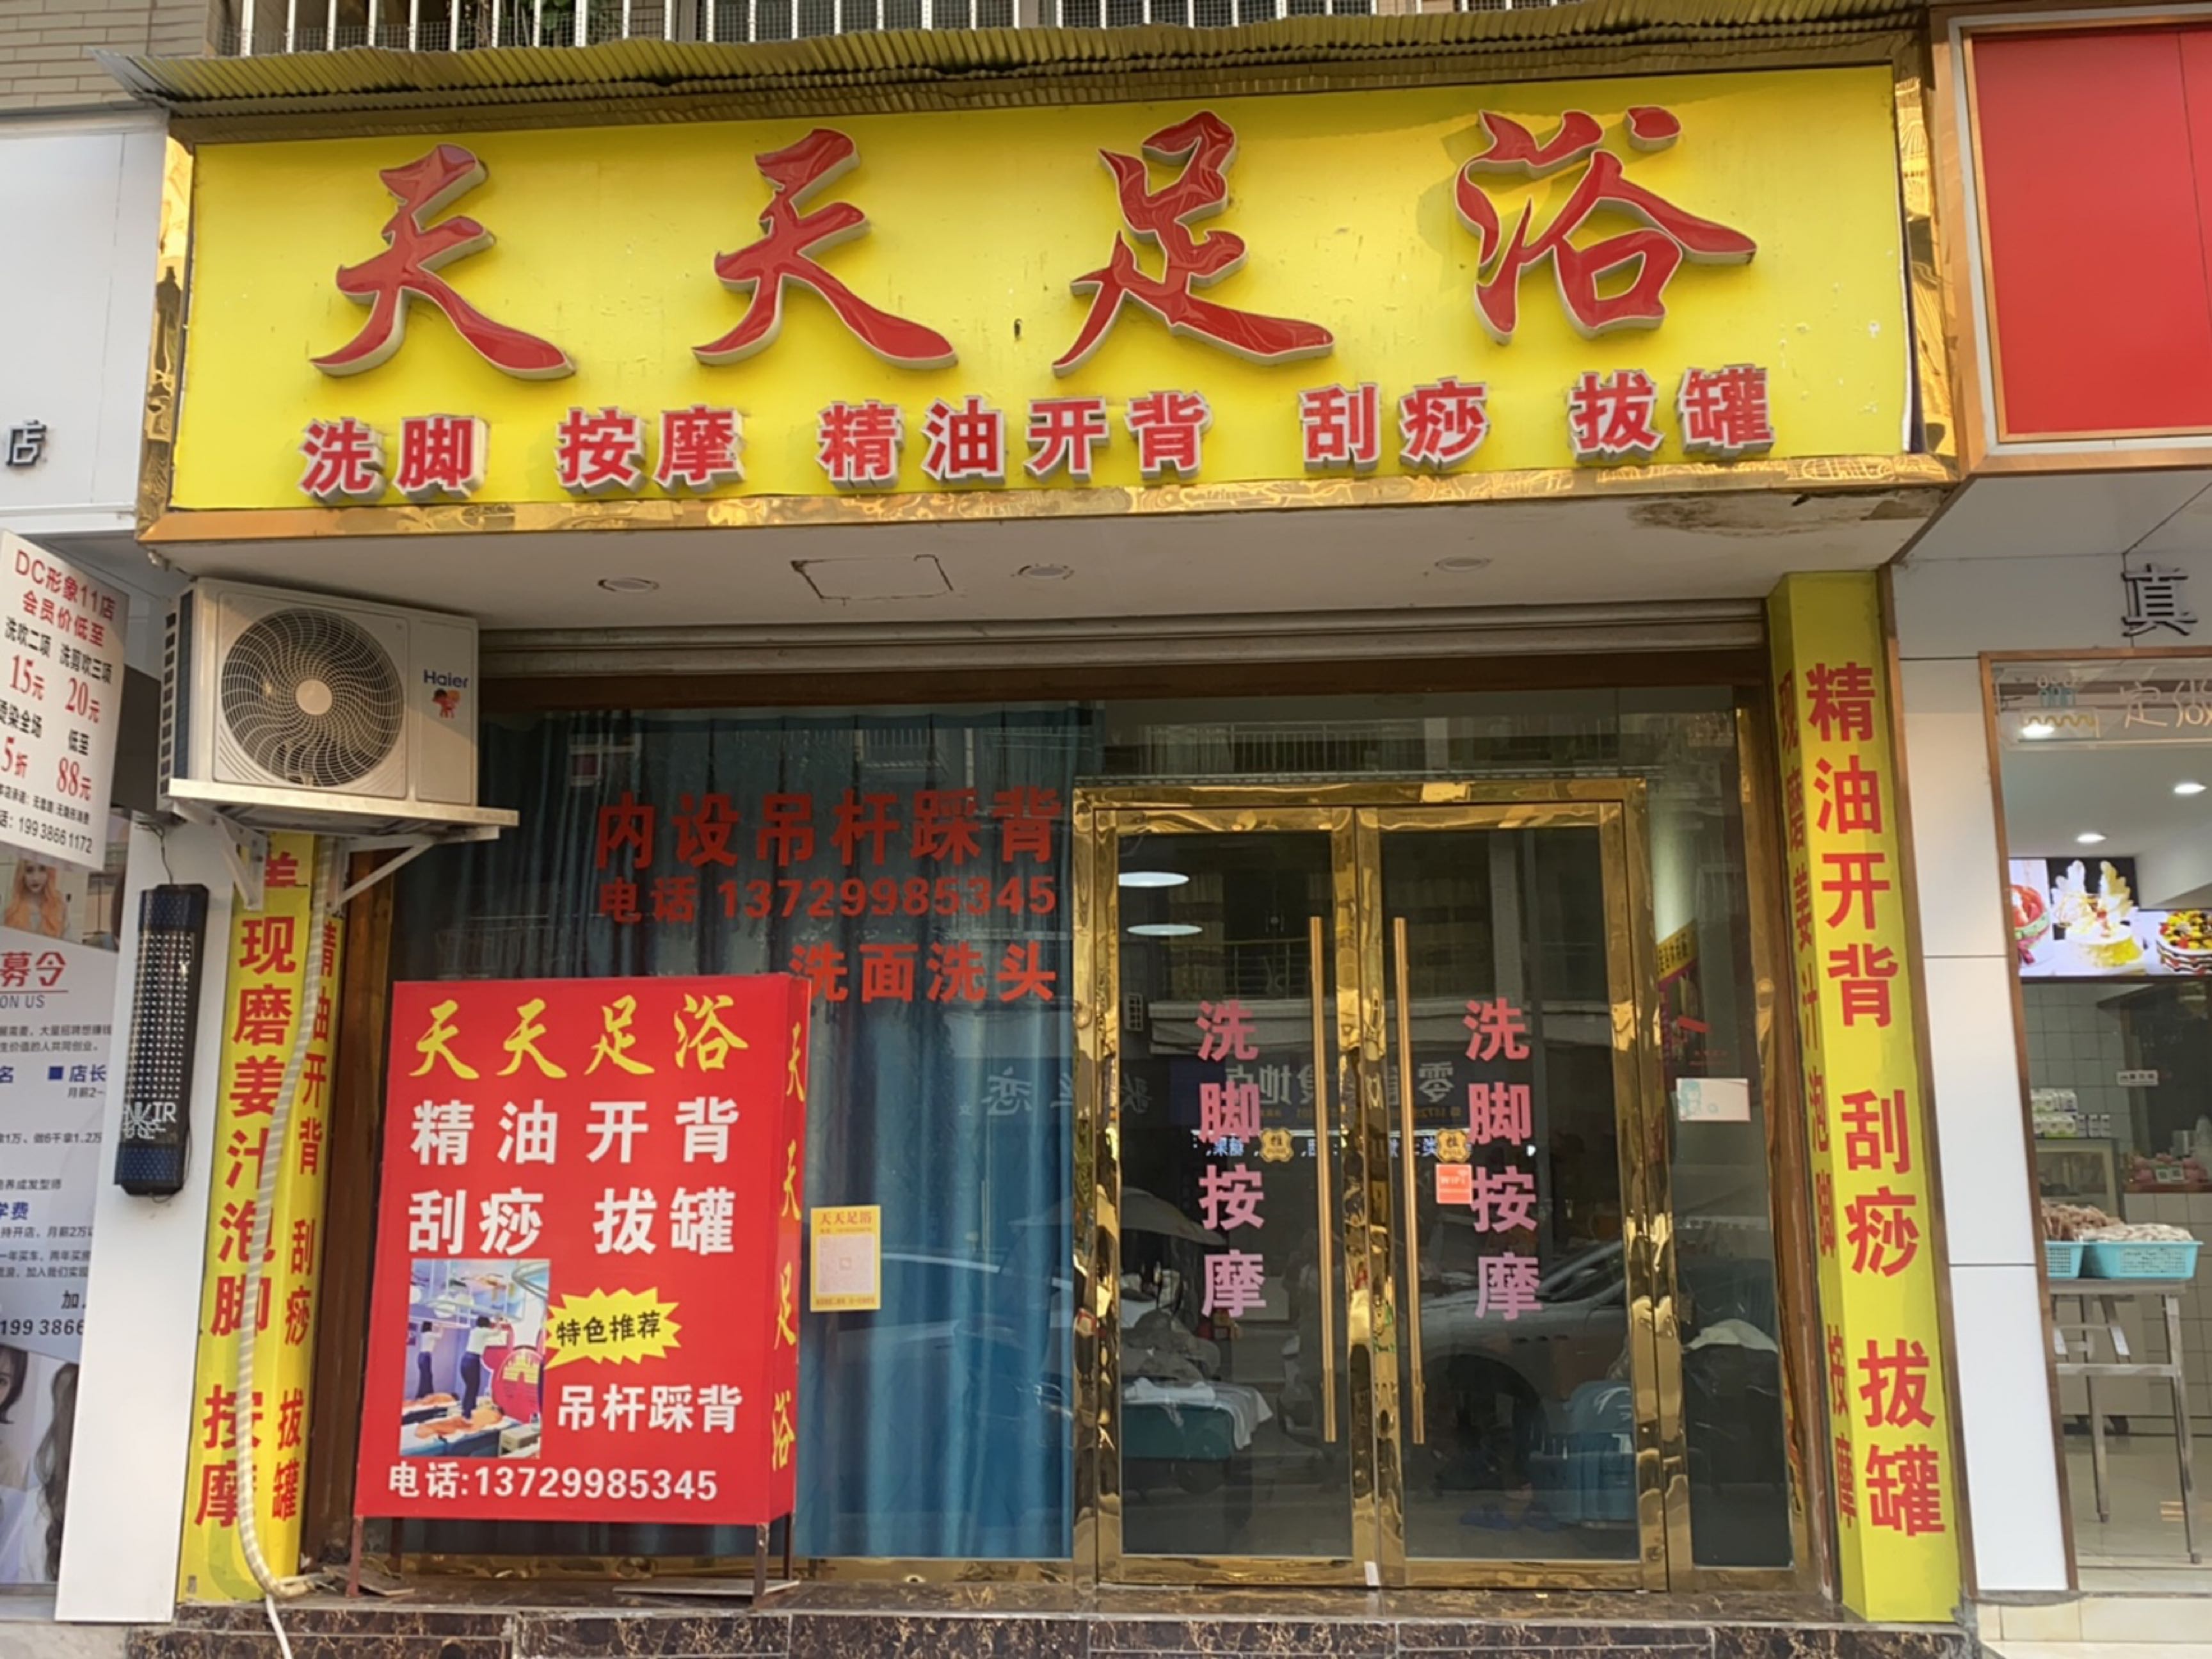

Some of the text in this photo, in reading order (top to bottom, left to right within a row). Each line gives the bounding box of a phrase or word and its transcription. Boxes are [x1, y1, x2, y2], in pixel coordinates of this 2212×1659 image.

[307, 106, 1758, 380] 天天足浴
[6, 419, 47, 467] 店
[299, 365, 1775, 507] 洗脚 按摩 精油开背 刮痧 拔罐
[15, 549, 116, 621] DC形象11店
[23, 589, 105, 647] 会员价低至
[2120, 563, 2199, 637] 真
[10, 654, 100, 724] 15元 20元
[422, 669, 469, 689] Haier
[56, 757, 92, 801] 88元
[595, 785, 1063, 870] 内设吊杆踩背
[1805, 661, 1899, 1028] 精油开背
[598, 874, 1057, 923] 电话 13729985345
[25, 995, 45, 1009] US
[788, 941, 1057, 1004] 洗面洗头
[408, 993, 748, 1080] 天天足浴
[69, 1064, 107, 1083] 店长
[410, 1096, 740, 1166] 精油开背
[1194, 1000, 1267, 1318] 洗脚按摩
[1461, 996, 1543, 1321] 洗脚按摩
[1840, 1089, 1921, 1278] 刮痧
[408, 1186, 736, 1256] 刮痧 拔罐
[771, 1021, 805, 1471] 天天足浴
[284, 1218, 316, 1347] 刮痧
[555, 1310, 662, 1348] 特色推荐
[556, 1384, 743, 1434] 吊杆踩背
[1858, 1338, 1946, 1537] 拔罐
[271, 1387, 304, 1522] 拔罐
